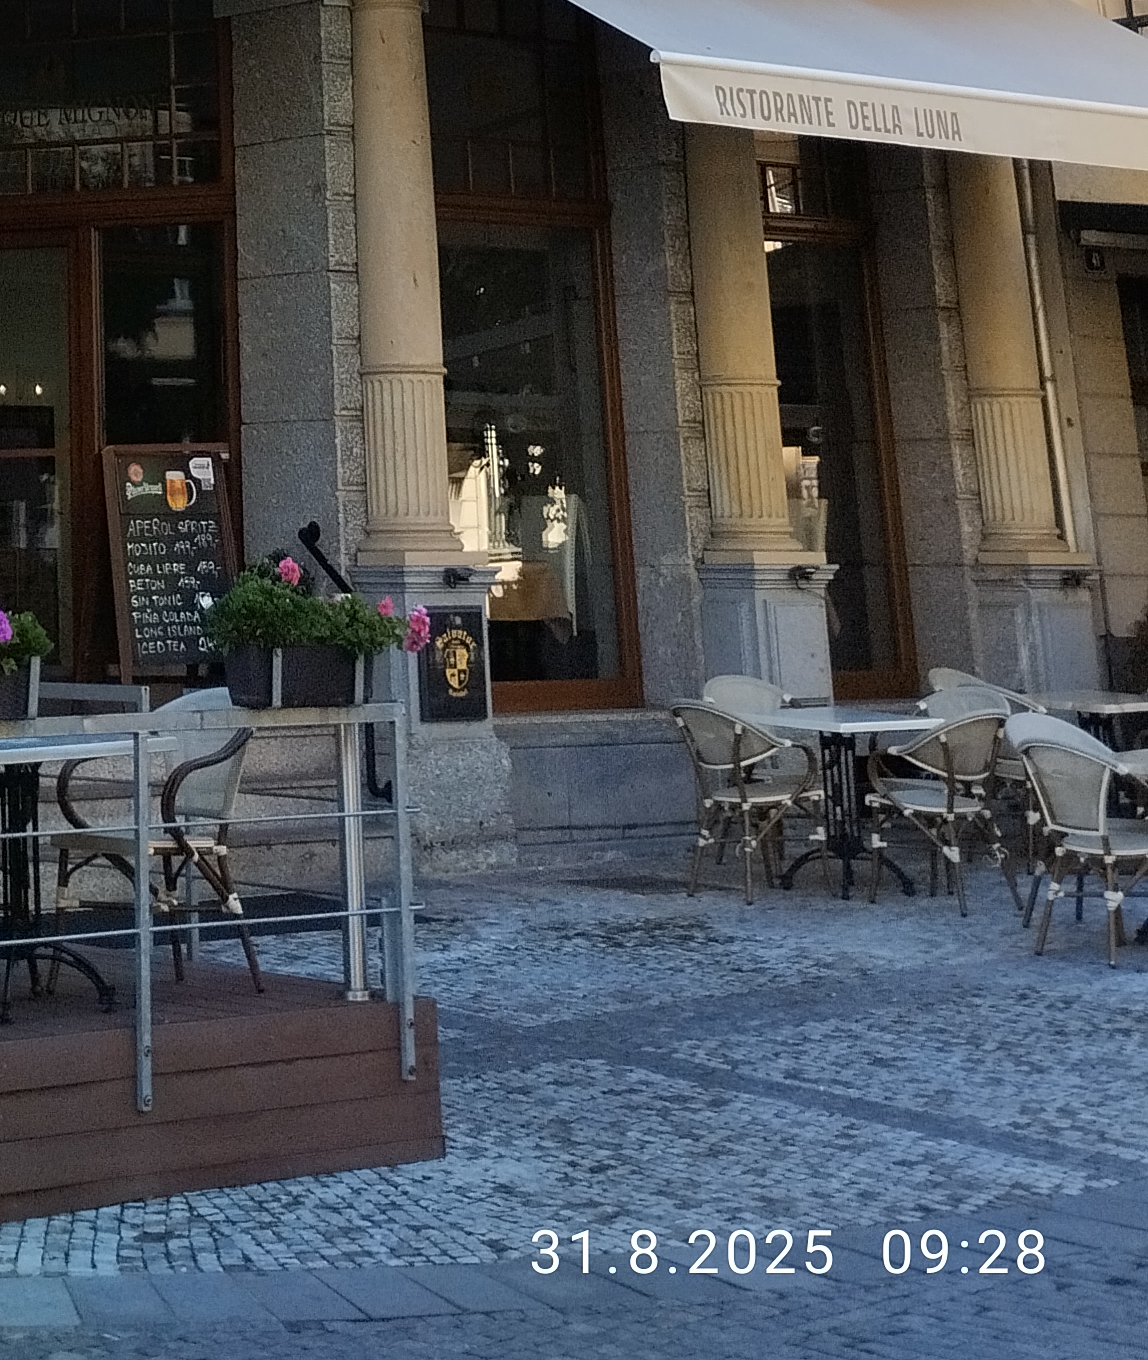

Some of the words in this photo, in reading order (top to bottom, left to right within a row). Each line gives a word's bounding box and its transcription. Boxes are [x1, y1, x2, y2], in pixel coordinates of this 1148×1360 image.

[714, 85, 836, 128] RISTORANTE
[846, 99, 903, 135] DELLA
[913, 107, 963, 142] LUNA
[127, 518, 175, 537] APEROL
[127, 542, 167, 556] MOJITO
[127, 562, 153, 576] CUBA
[152, 593, 183, 606] TONIC
[162, 610, 201, 623] COLADA
[167, 625, 203, 638] ISLAND
[166, 640, 187, 653] TEA
